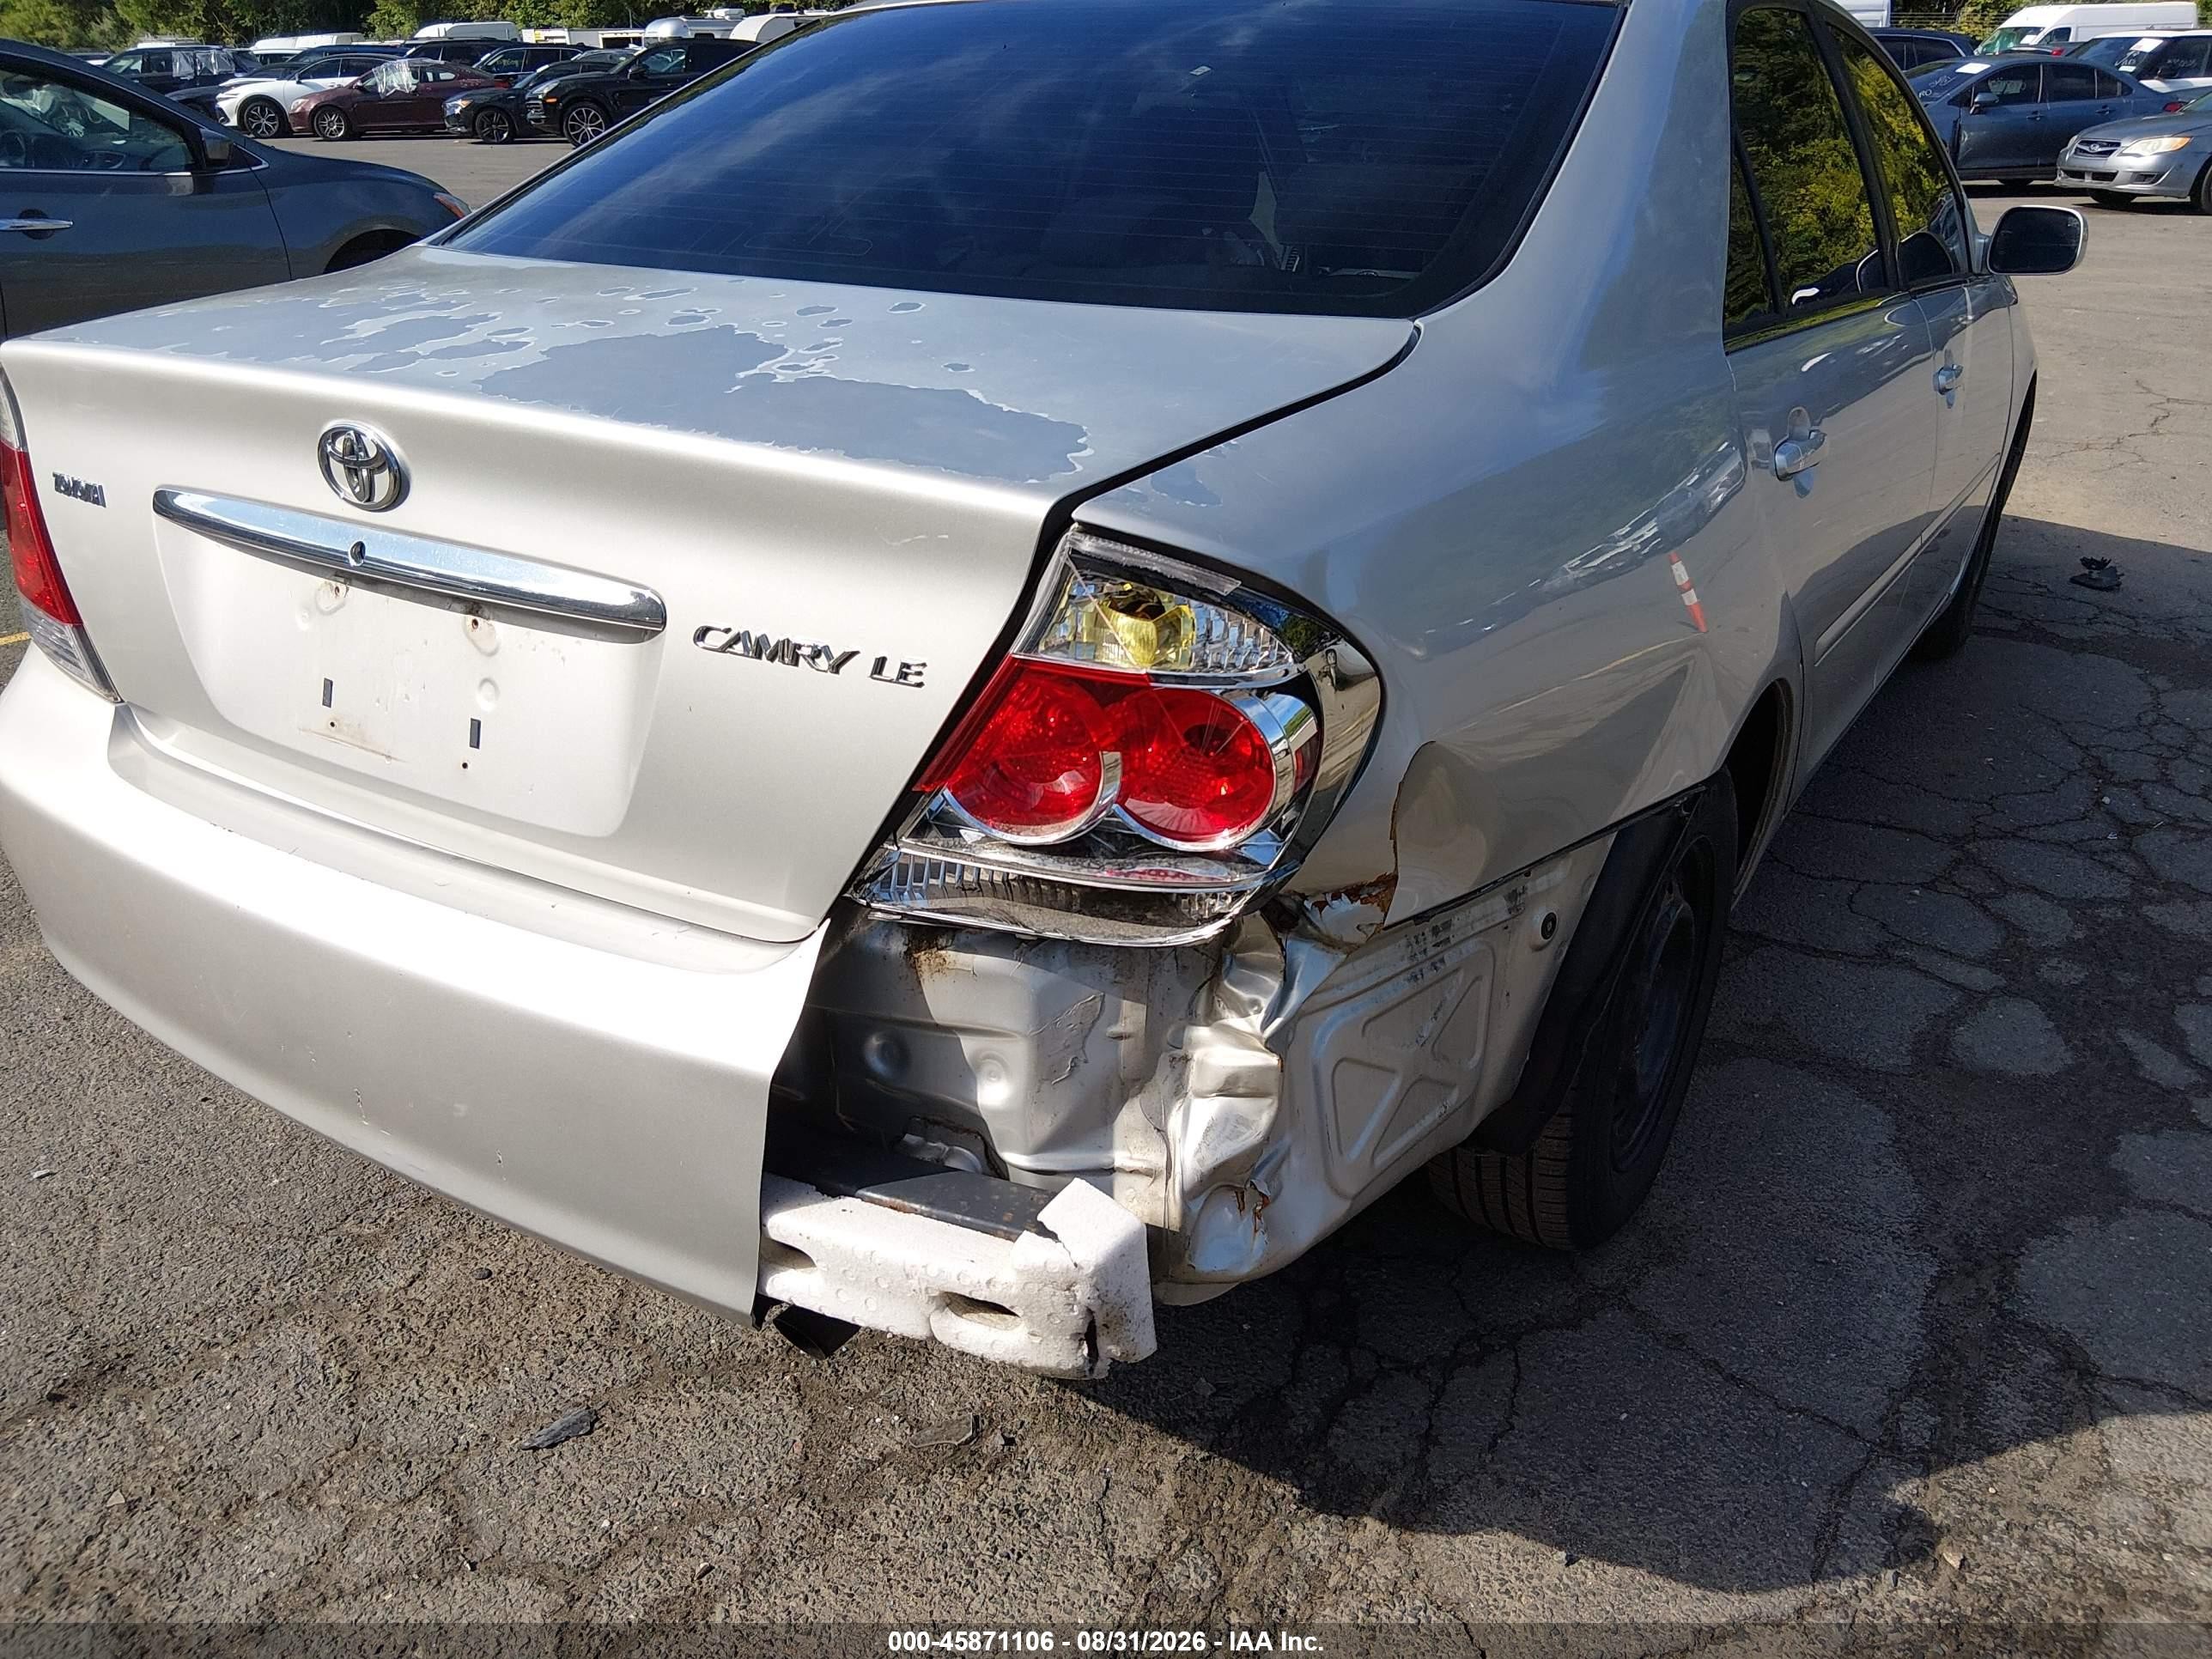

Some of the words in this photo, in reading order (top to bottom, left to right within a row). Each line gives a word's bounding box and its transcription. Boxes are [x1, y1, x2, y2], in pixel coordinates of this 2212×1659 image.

[52, 471, 106, 507] TOYOTA
[692, 625, 860, 674] CAMRY
[868, 656, 927, 688] LE
